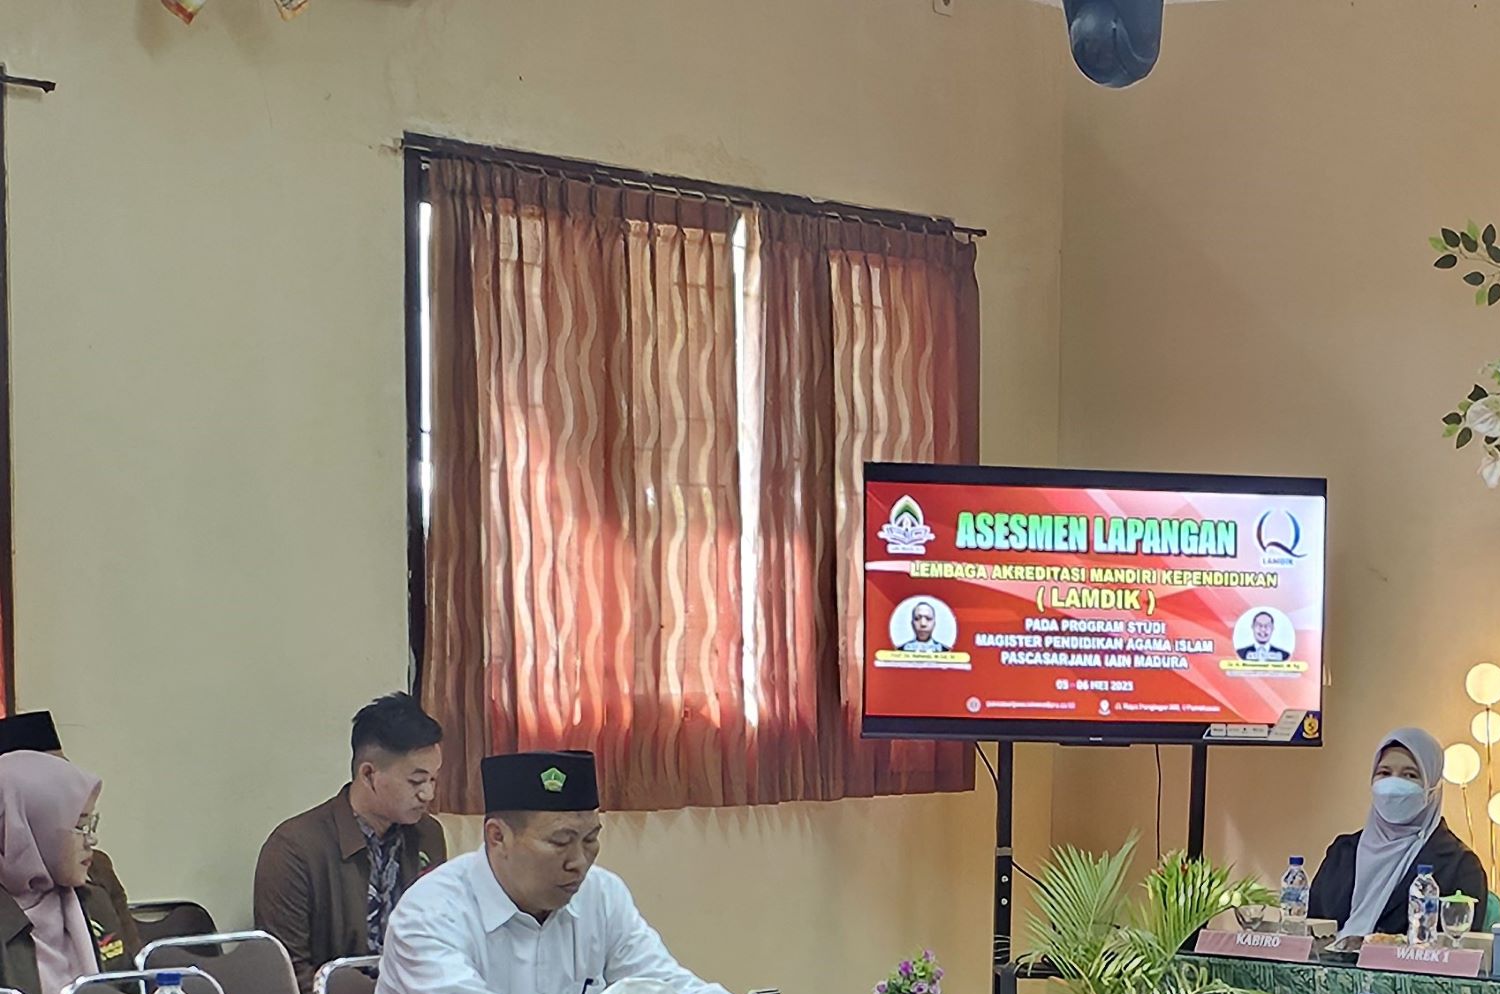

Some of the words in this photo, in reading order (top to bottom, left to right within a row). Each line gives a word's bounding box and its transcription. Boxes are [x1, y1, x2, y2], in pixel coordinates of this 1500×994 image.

[956, 512, 1090, 553] ASESMEN
[1094, 517, 1237, 558] LAPANGAN
[911, 561, 988, 579] LEMBAGA
[992, 564, 1086, 582] AKREDITASI
[1090, 568, 1157, 584] MANDIRI
[1162, 570, 1278, 587] KEPENDIDIKAN
[1052, 587, 1141, 610] LAMDIK
[1025, 618, 1059, 632] PADA
[1061, 619, 1124, 633] PROGRAM
[1127, 621, 1166, 634] STUDI
[975, 634, 1042, 648] MAGISTER
[1045, 635, 1124, 651] PENDIDIKAN
[1126, 637, 1172, 652] AGAMA
[1174, 639, 1214, 653] ISLAM
[1001, 651, 1101, 667] PASCASARJANA
[1104, 653, 1131, 667] IAIN
[1134, 655, 1189, 669] MADURA
[1236, 932, 1281, 948] KABIRO
[1396, 947, 1440, 962] WAREK
